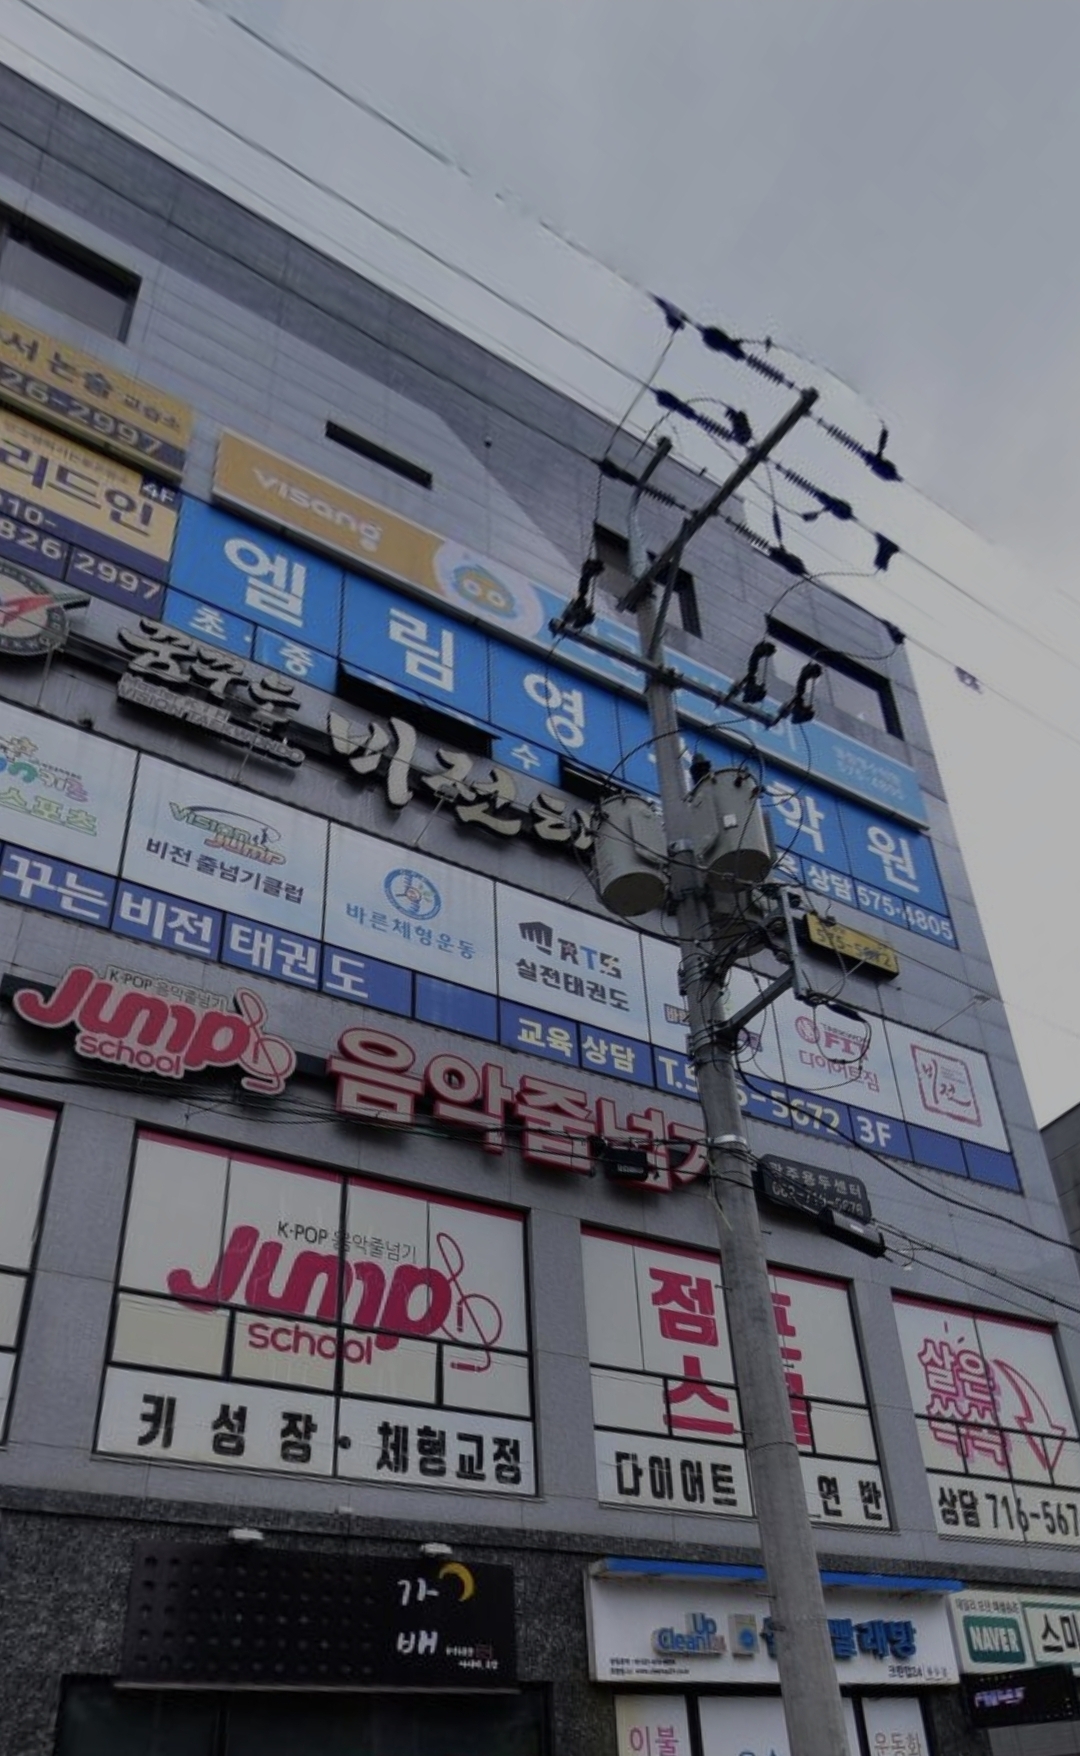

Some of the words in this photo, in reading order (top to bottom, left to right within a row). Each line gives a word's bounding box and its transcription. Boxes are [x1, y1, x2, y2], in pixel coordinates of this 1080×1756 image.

[142, 480, 178, 505] 4F
[145, 836, 193, 868] 비전
[195, 855, 305, 906] 줄넘기클럽
[345, 902, 477, 962] 바른체형운동
[807, 865, 853, 901] 상담
[855, 884, 955, 942] 575-4805
[229, 923, 371, 1000] 태권도
[516, 956, 631, 1013] 실전태권도
[79, 1031, 183, 1077] school
[516, 1017, 574, 1058] 교육
[581, 1034, 636, 1074] 상담
[856, 1114, 893, 1148] 3F
[277, 1220, 329, 1246] K-POP
[247, 1321, 374, 1366] school
[376, 1420, 522, 1486] 체형교정
[615, 1450, 740, 1508] 다이어트
[938, 1486, 981, 1528] 상담
[968, 1623, 1021, 1655] NAVER
